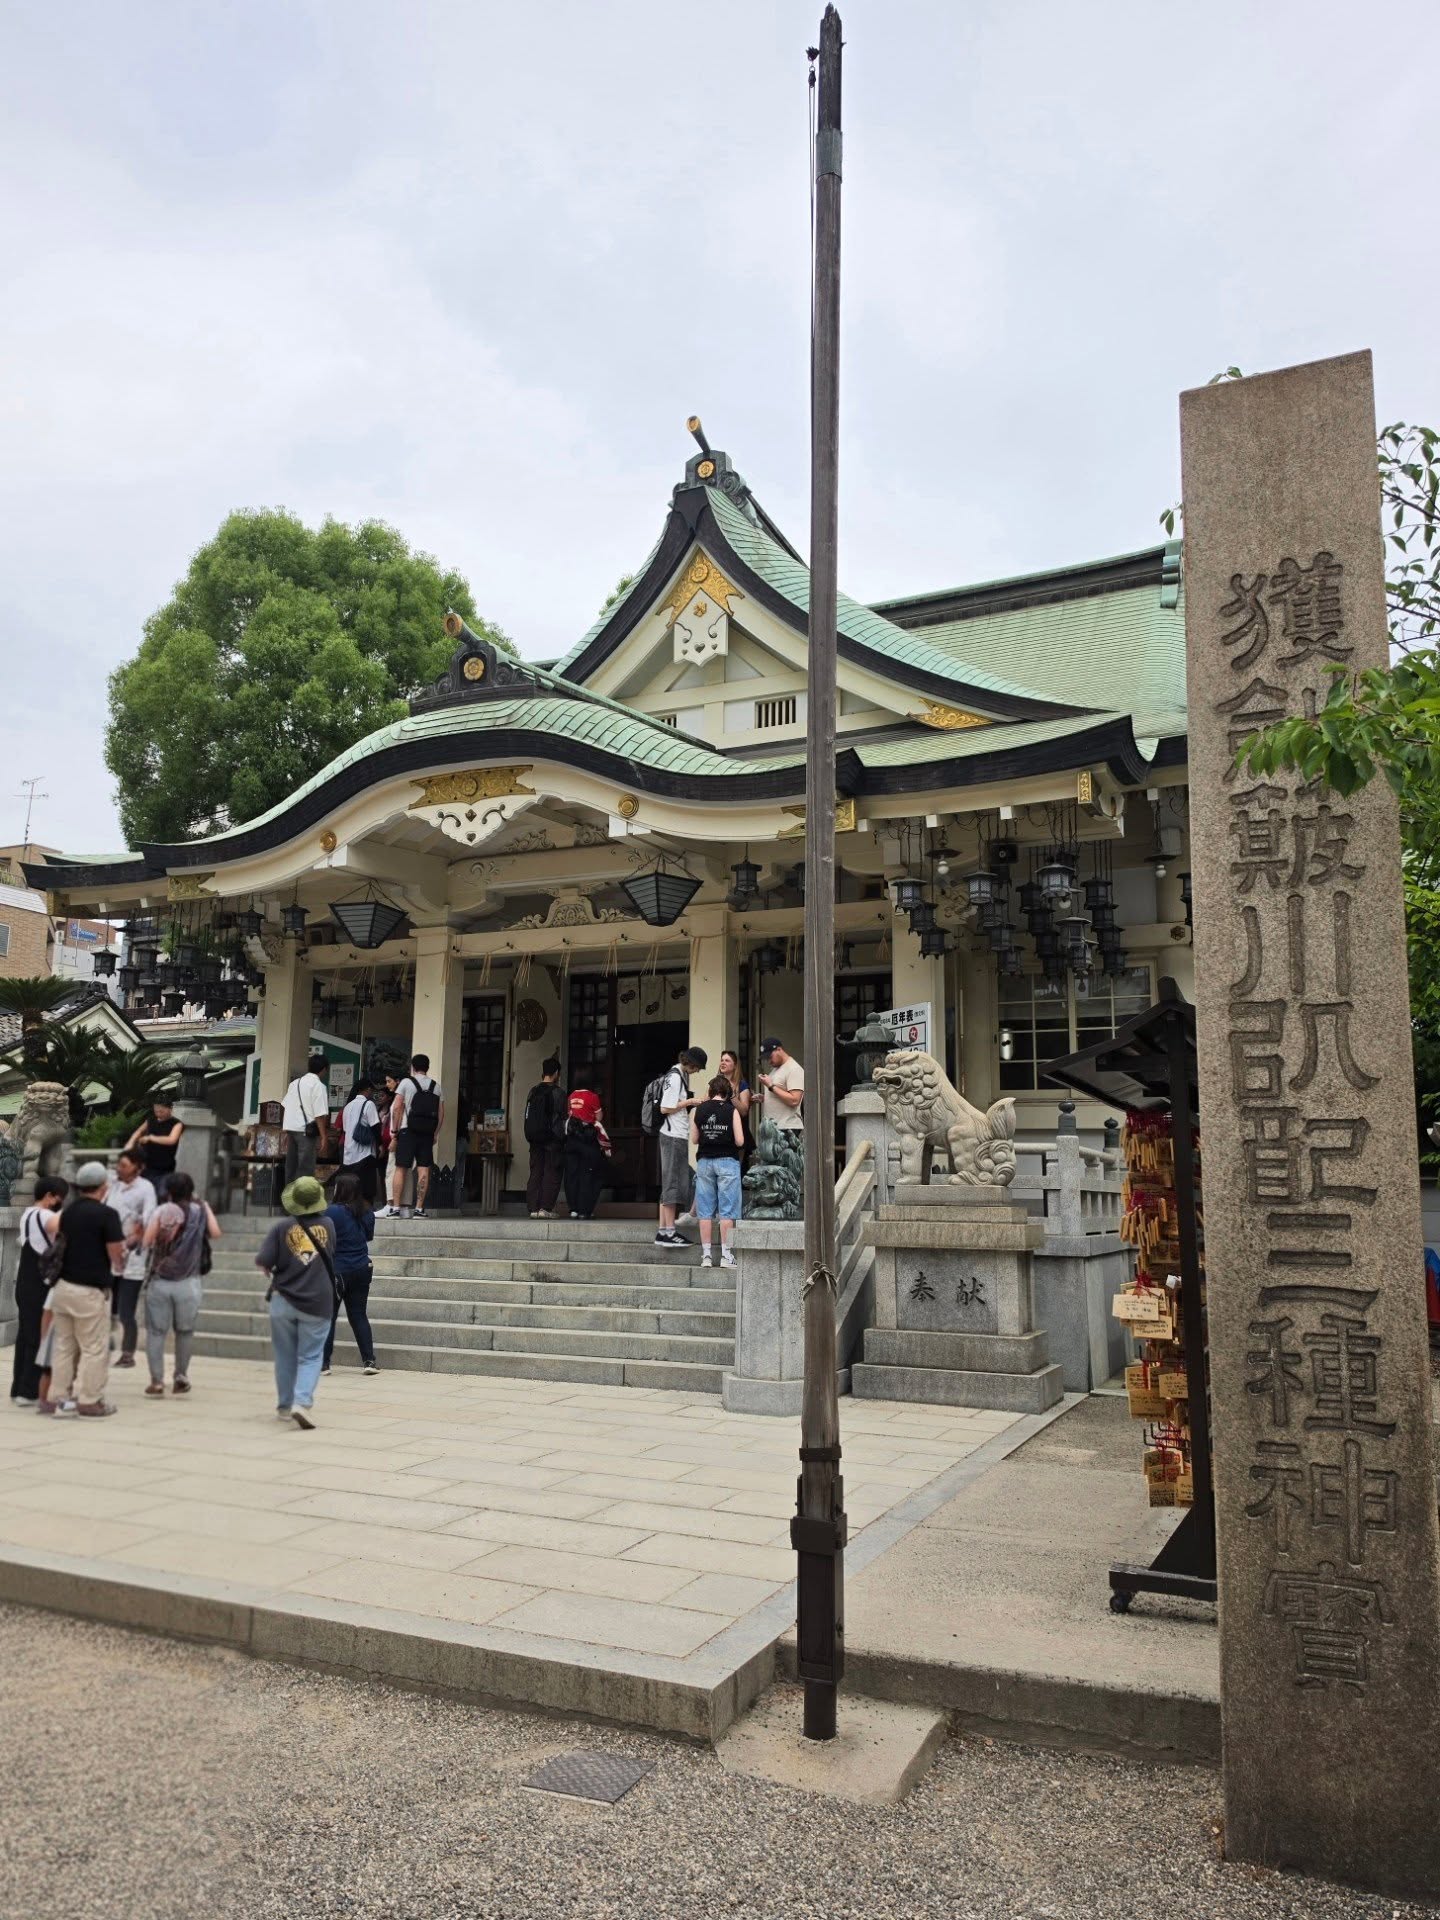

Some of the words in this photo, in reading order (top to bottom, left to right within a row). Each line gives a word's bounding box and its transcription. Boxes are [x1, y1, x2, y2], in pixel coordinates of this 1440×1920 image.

[891, 1009, 914, 1025] 厄年表
[910, 1271, 986, 1305] 奉献
